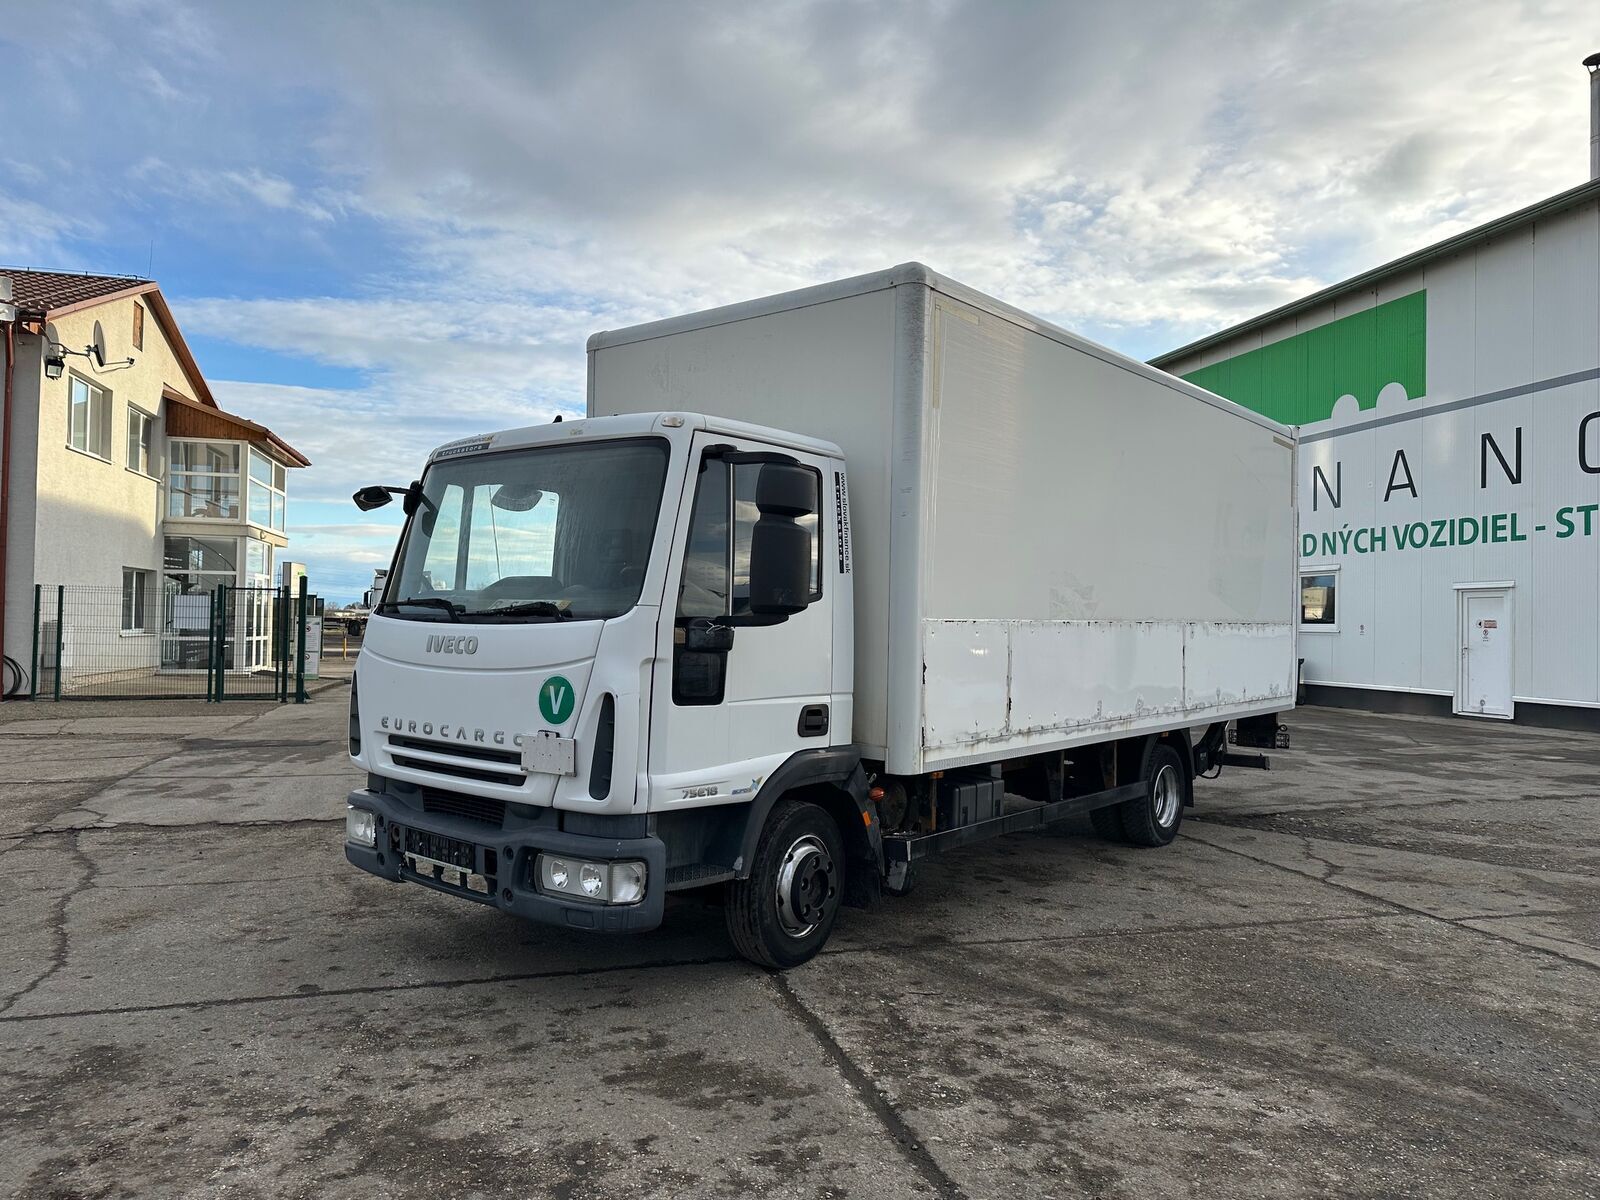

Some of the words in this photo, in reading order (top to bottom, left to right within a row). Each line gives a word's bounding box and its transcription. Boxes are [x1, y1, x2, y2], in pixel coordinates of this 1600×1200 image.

[840, 472, 851, 574] www.slovakfinance.sk
[1299, 523, 1387, 558] DNÝCH
[1392, 512, 1527, 551] VOZIDIEL
[1555, 503, 1599, 539] ST
[425, 634, 479, 655] IVECO
[549, 685, 566, 715] V
